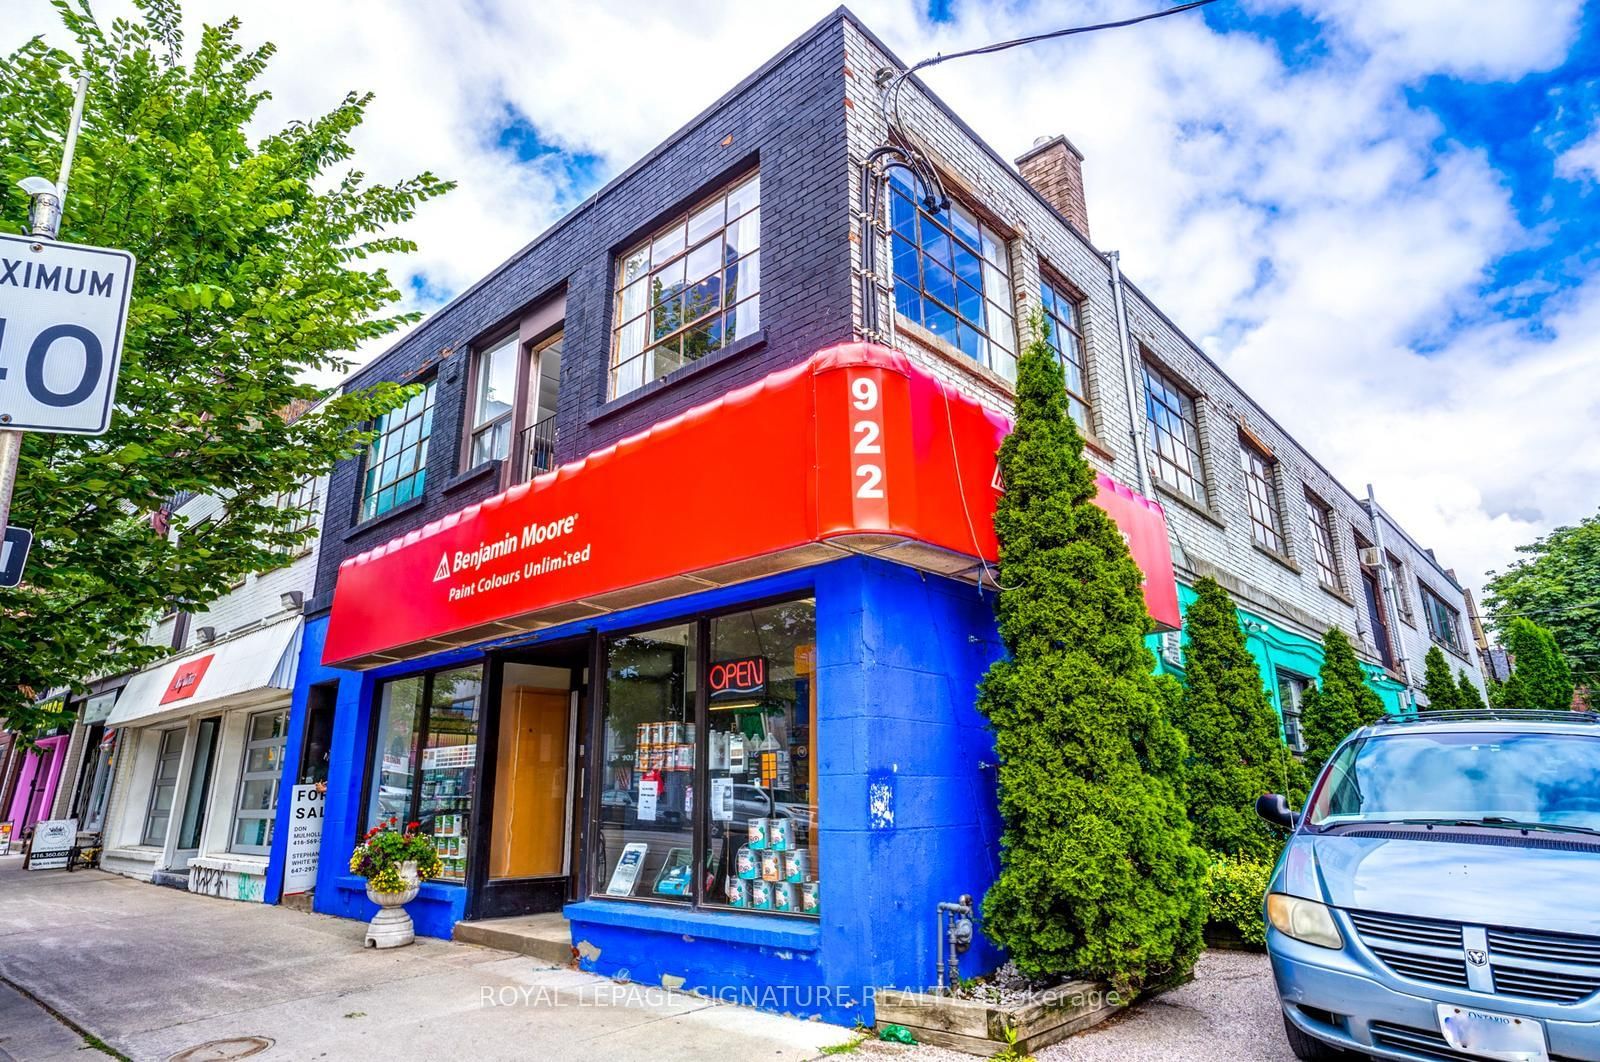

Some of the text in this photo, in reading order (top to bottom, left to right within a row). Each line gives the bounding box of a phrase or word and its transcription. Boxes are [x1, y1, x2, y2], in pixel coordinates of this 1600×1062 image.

[0, 257, 115, 298] XIMUM
[851, 377, 884, 499] 922
[452, 532, 518, 573] Benjamin
[448, 582, 475, 602] Paint
[477, 569, 521, 593] Colours
[709, 658, 764, 690] OPEN
[295, 806, 325, 819] SAL
[1468, 1011, 1510, 1024] ONTARIO
